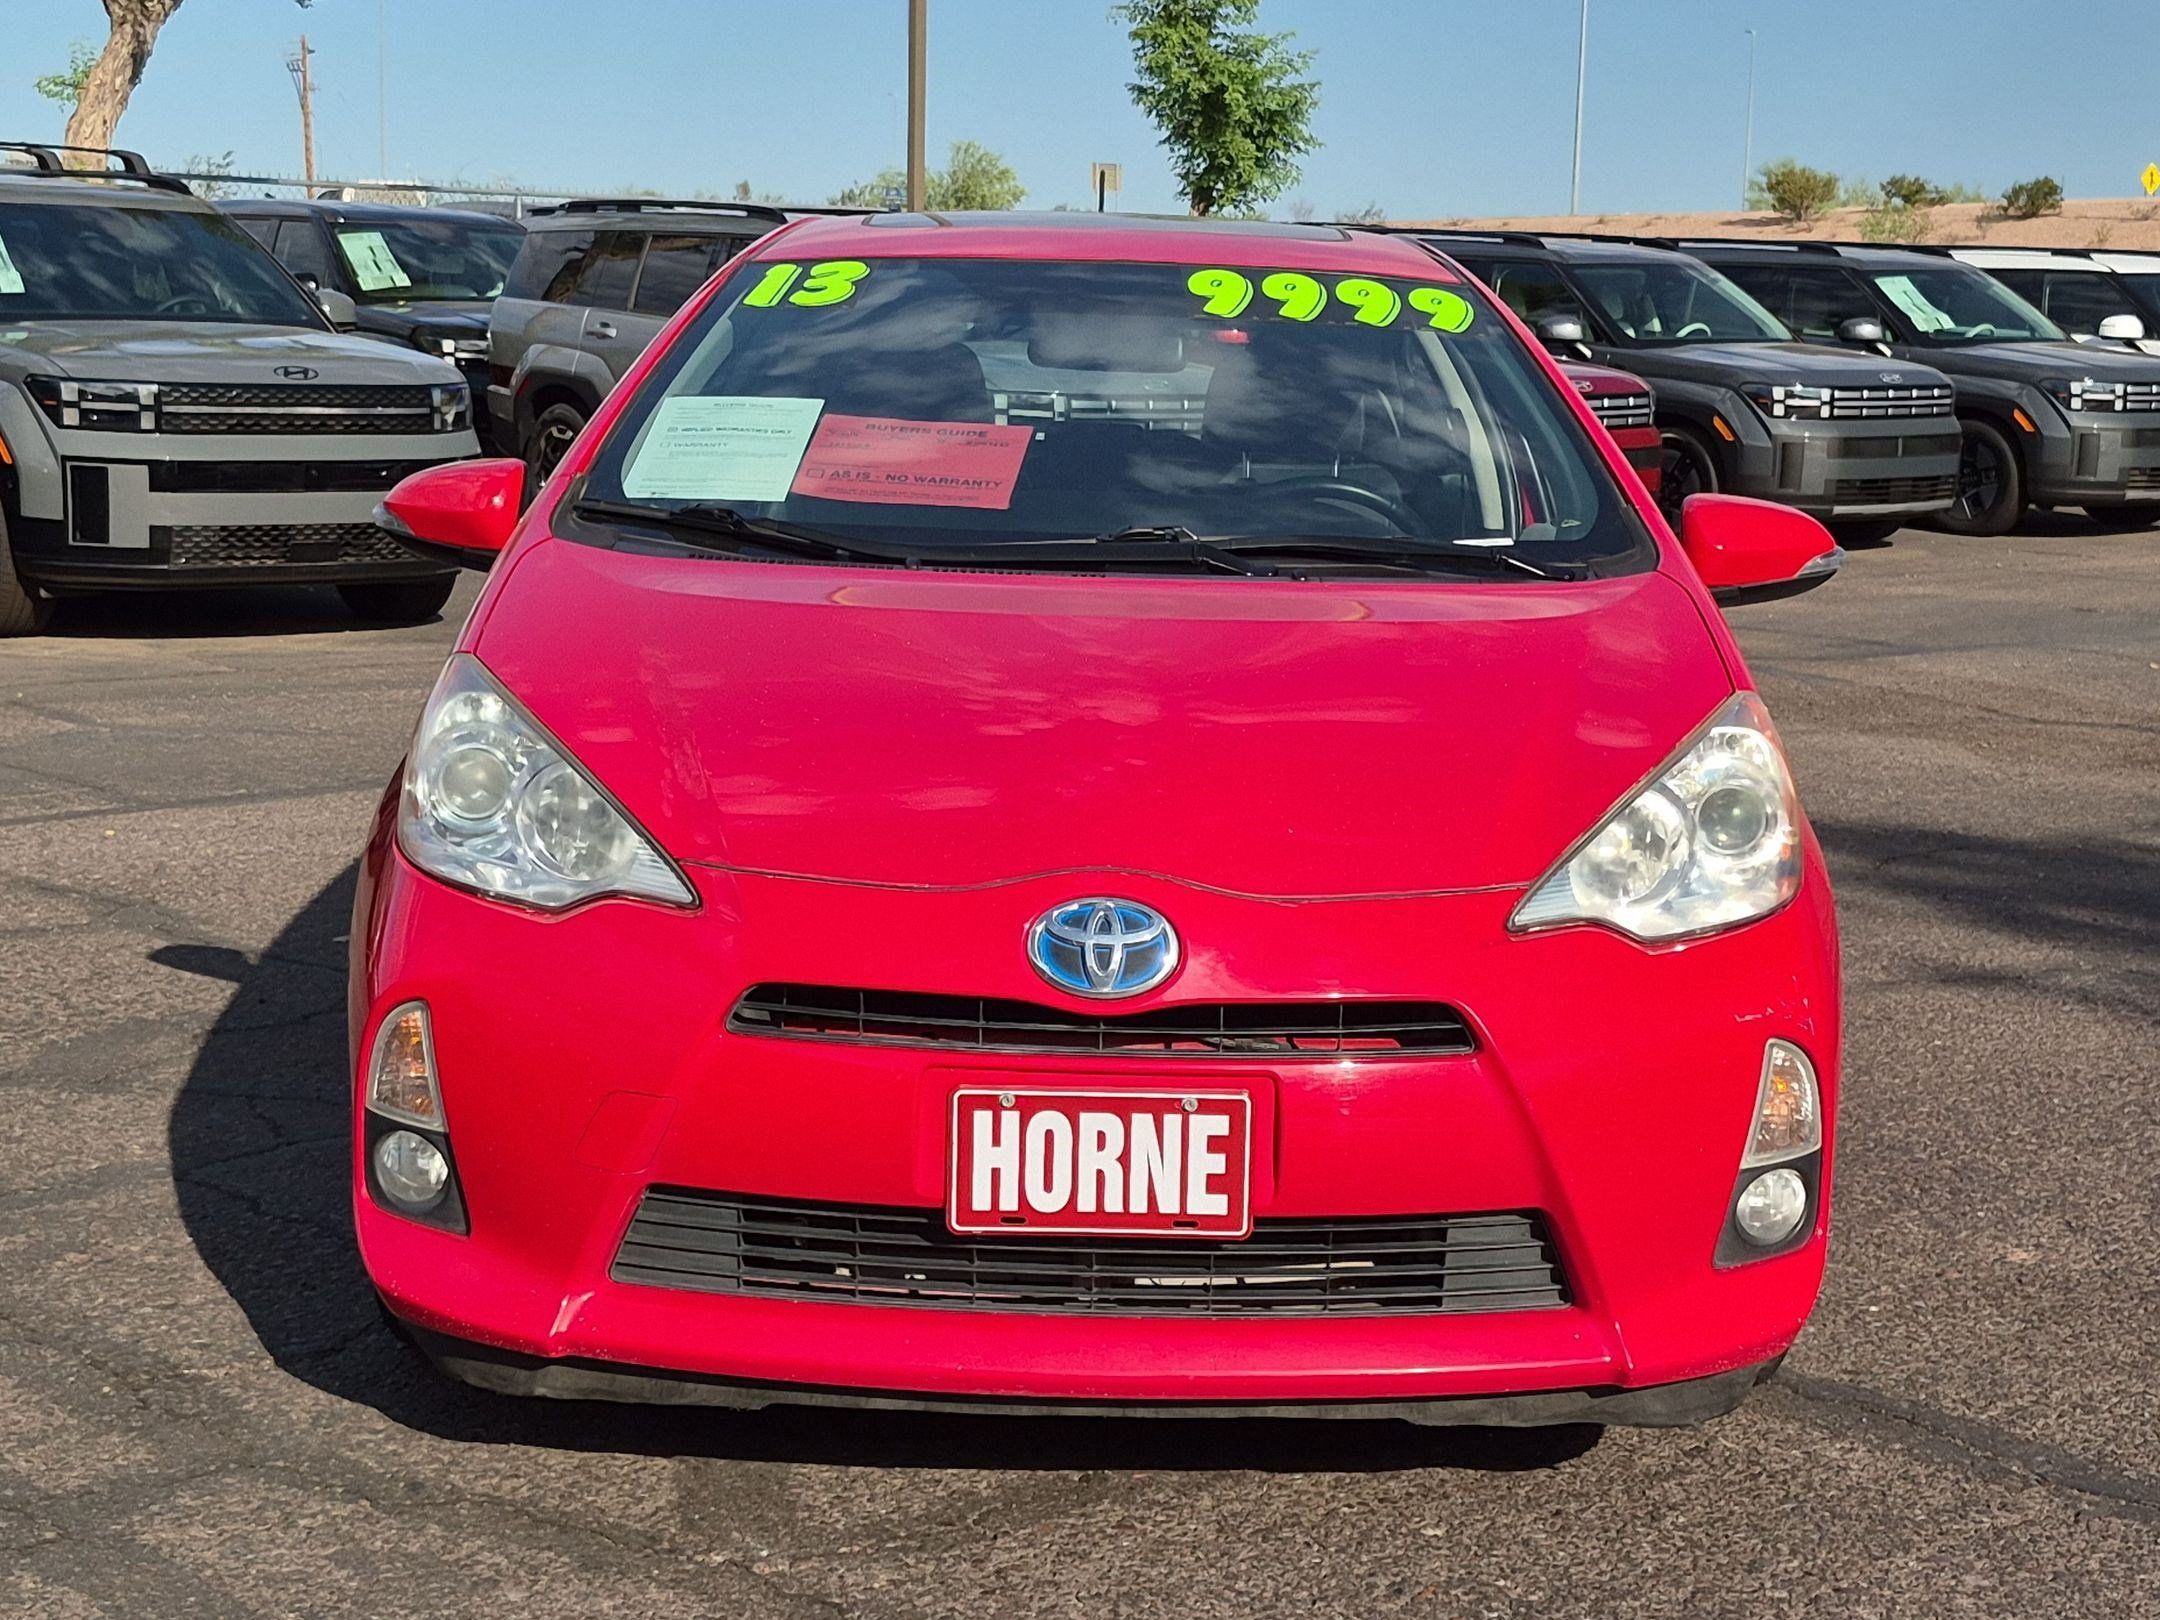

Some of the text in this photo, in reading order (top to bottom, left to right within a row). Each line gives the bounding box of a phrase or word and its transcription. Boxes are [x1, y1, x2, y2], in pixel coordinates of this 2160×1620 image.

[743, 260, 870, 307] 13
[1187, 269, 1474, 333] 9999
[864, 423, 932, 435] BUYERS
[937, 428, 989, 438] GUIDE
[830, 470, 850, 478] AS
[855, 471, 871, 480] IS
[885, 473, 909, 482] NO
[914, 475, 1003, 488] WARRANTY
[971, 1110, 1230, 1216] HORNE
